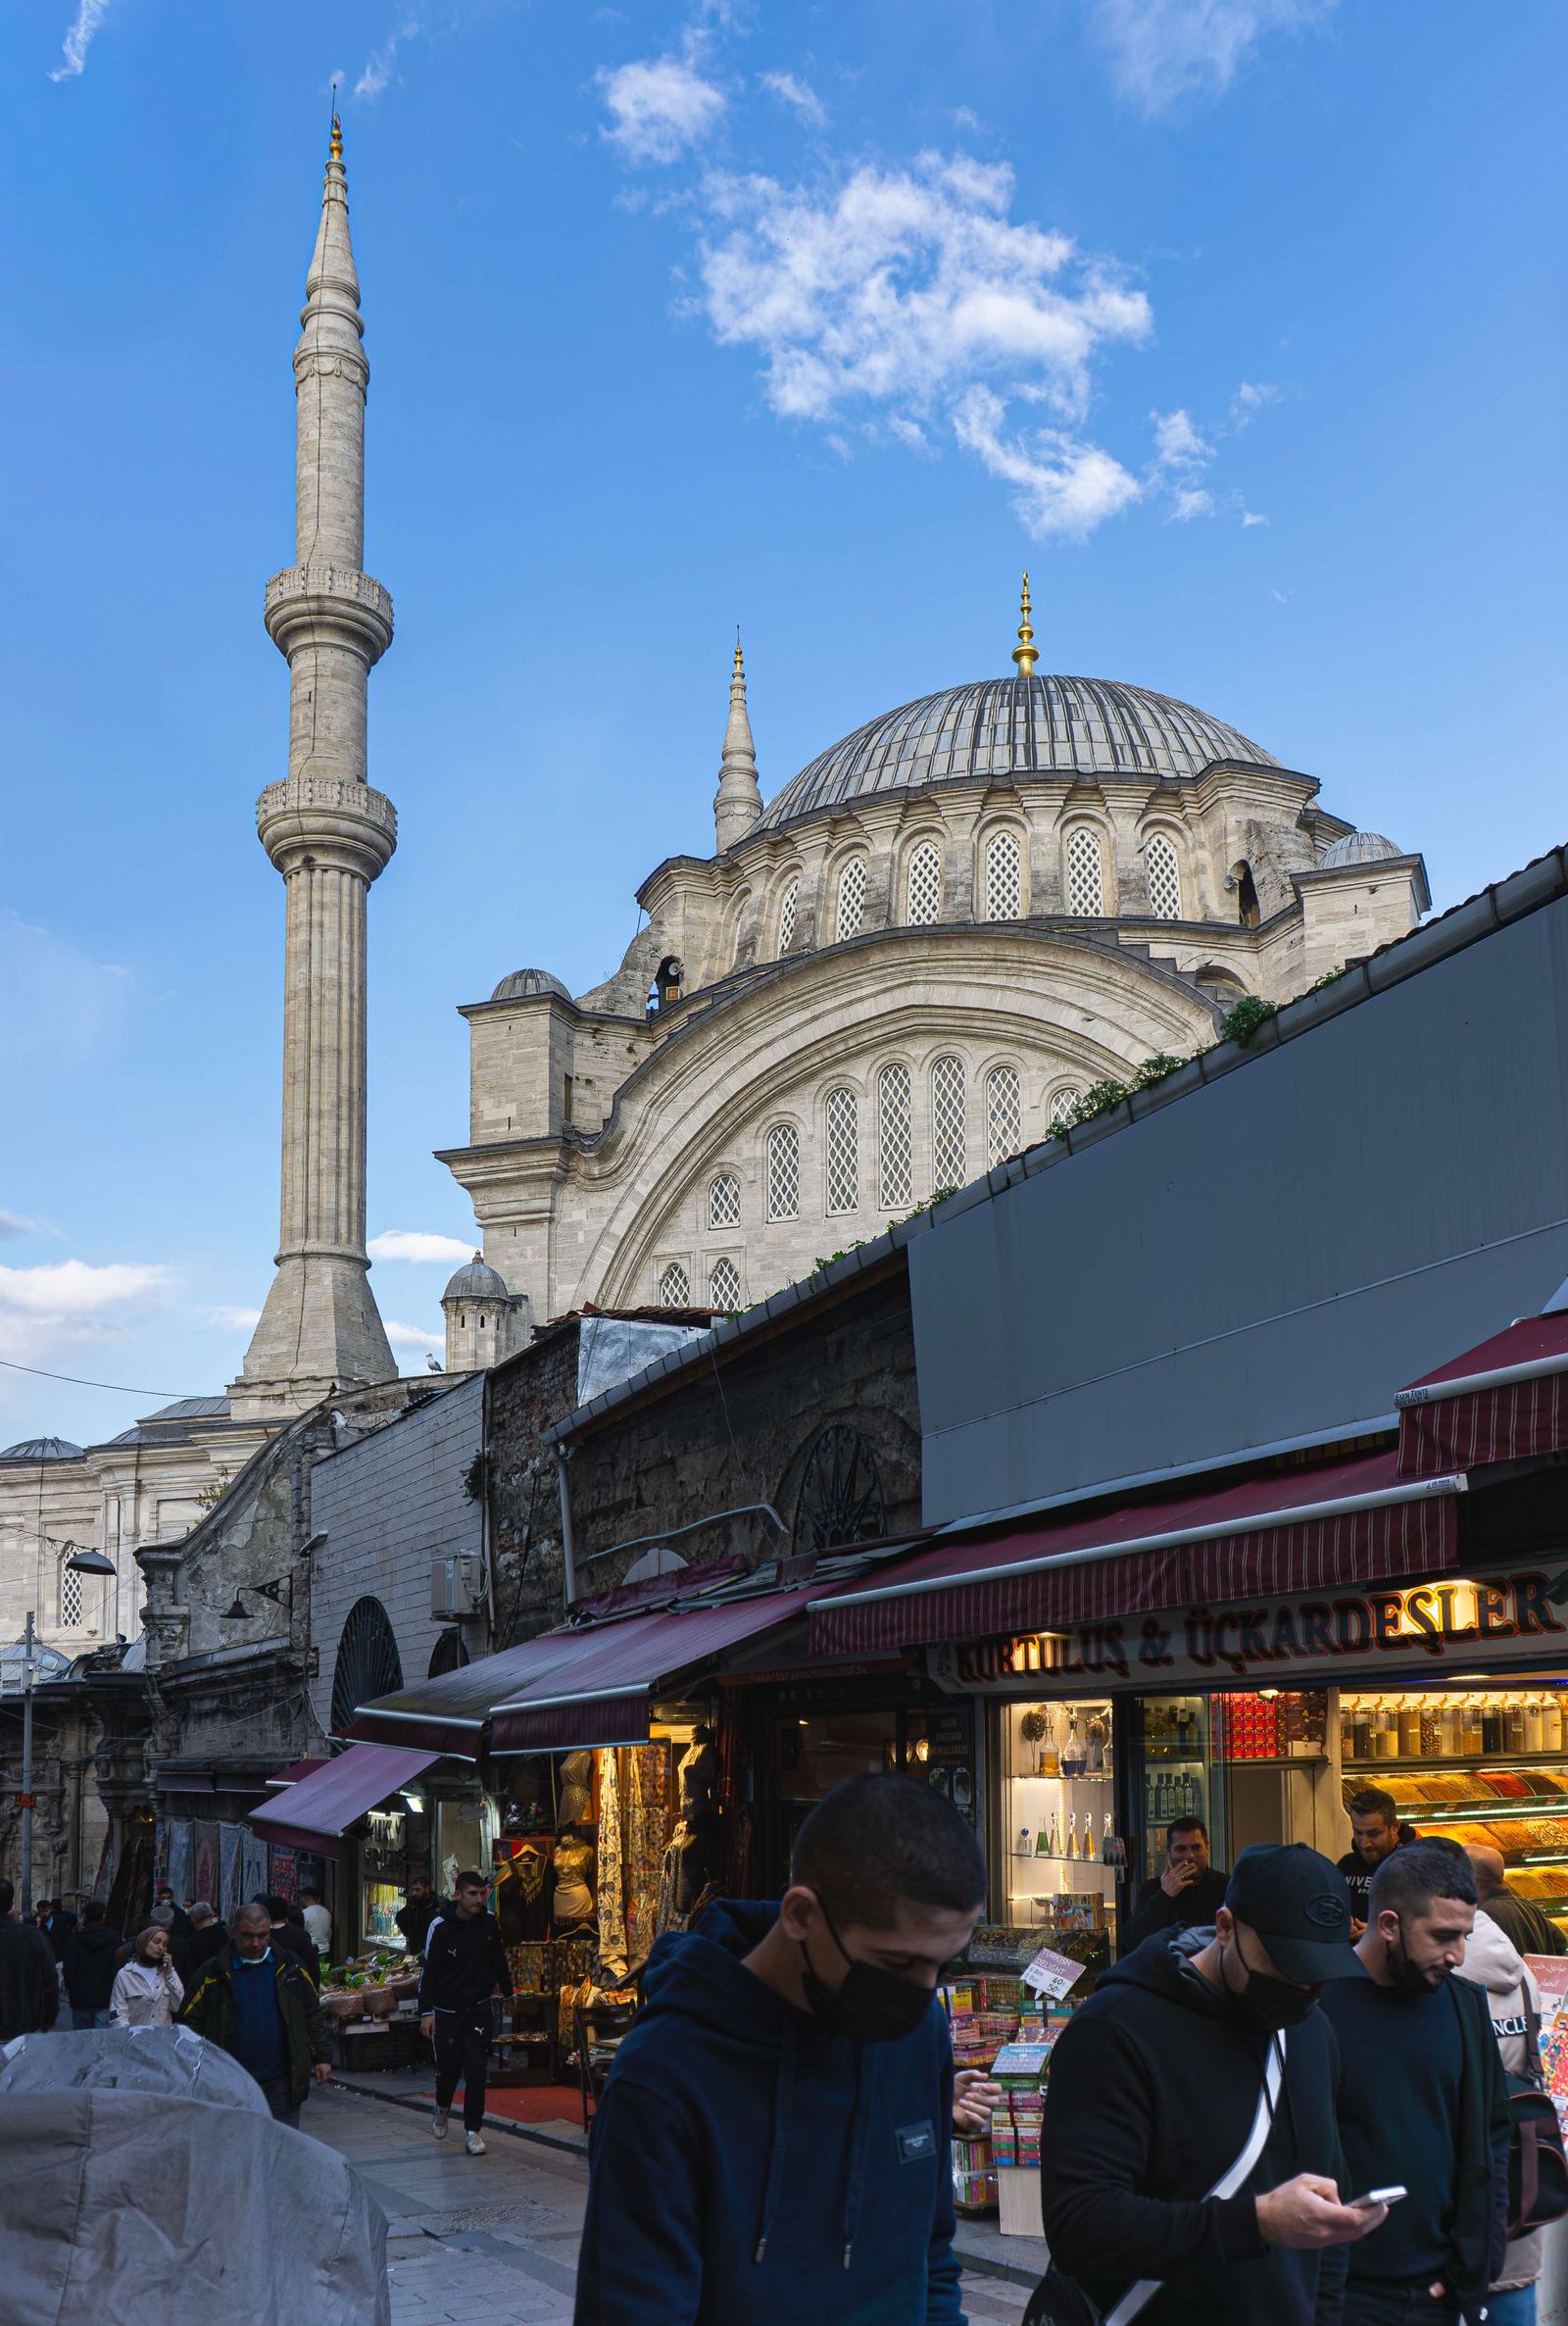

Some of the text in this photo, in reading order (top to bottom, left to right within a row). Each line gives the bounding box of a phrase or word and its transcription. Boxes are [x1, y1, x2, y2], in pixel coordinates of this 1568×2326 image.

[1138, 1616, 1175, 1668] &
[1183, 1571, 1566, 1676] ÜÇKARDEŞLER
[1034, 1957, 1066, 1976] DELIGHT
[1043, 1950, 1072, 1967] TURKISH
